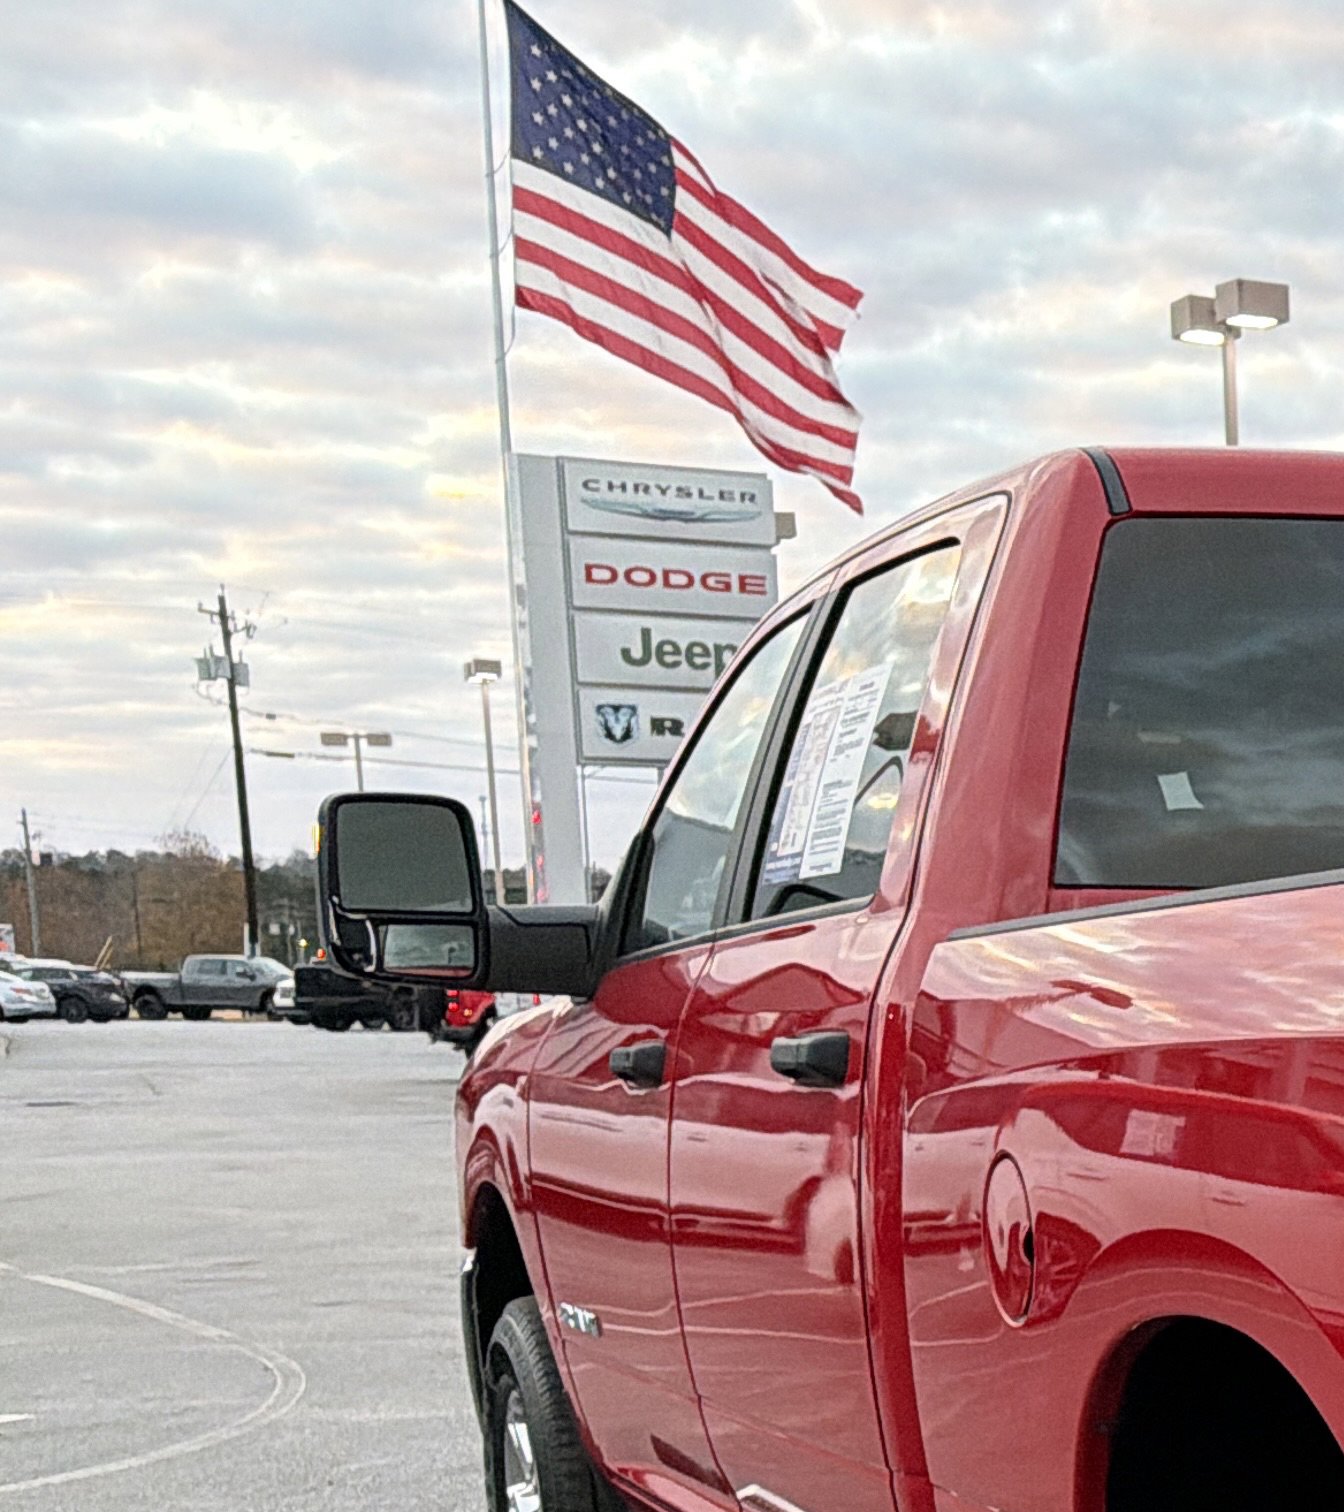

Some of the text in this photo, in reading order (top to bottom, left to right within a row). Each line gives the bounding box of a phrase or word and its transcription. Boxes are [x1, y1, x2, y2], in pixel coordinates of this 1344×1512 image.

[581, 477, 759, 505] CHRYSLER
[584, 563, 768, 596] DODGE
[620, 627, 740, 678] Jeep
